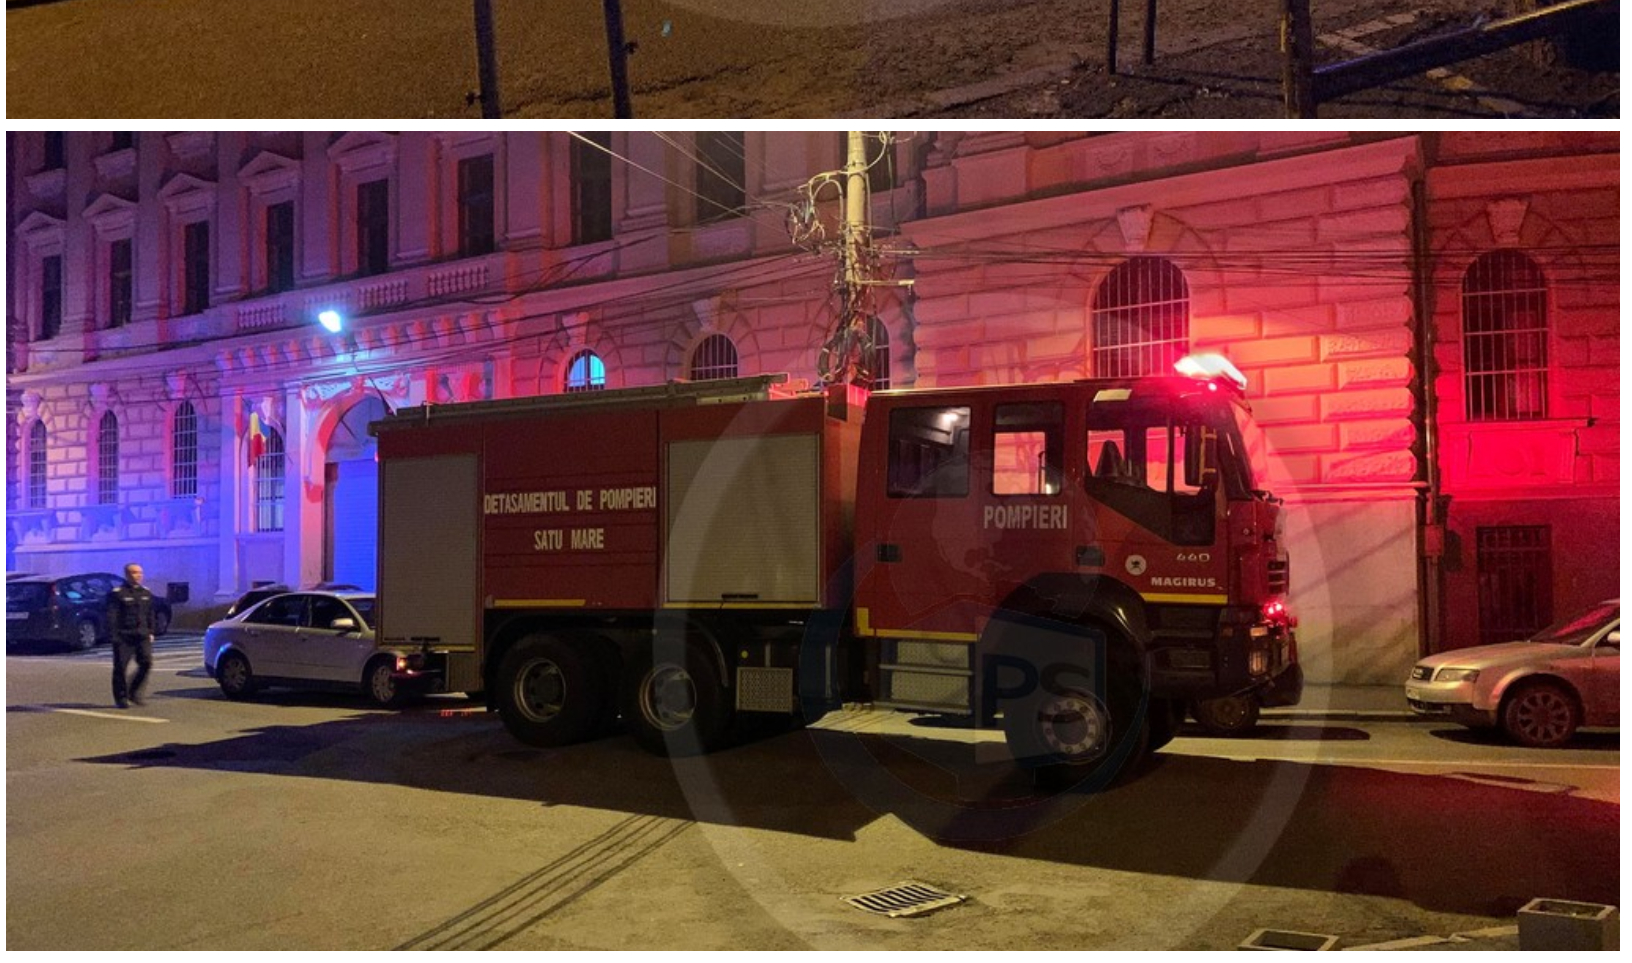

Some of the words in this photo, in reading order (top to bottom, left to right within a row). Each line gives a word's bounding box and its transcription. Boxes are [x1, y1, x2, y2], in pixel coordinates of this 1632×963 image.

[484, 489, 570, 515] DETASAMENTUL
[576, 489, 594, 510] DE
[599, 486, 657, 510] POMPIERI
[983, 505, 1068, 530] POMPIERI
[534, 529, 563, 551] SATU
[571, 527, 605, 550] MARE
[1150, 576, 1217, 589] MAGIRUS
